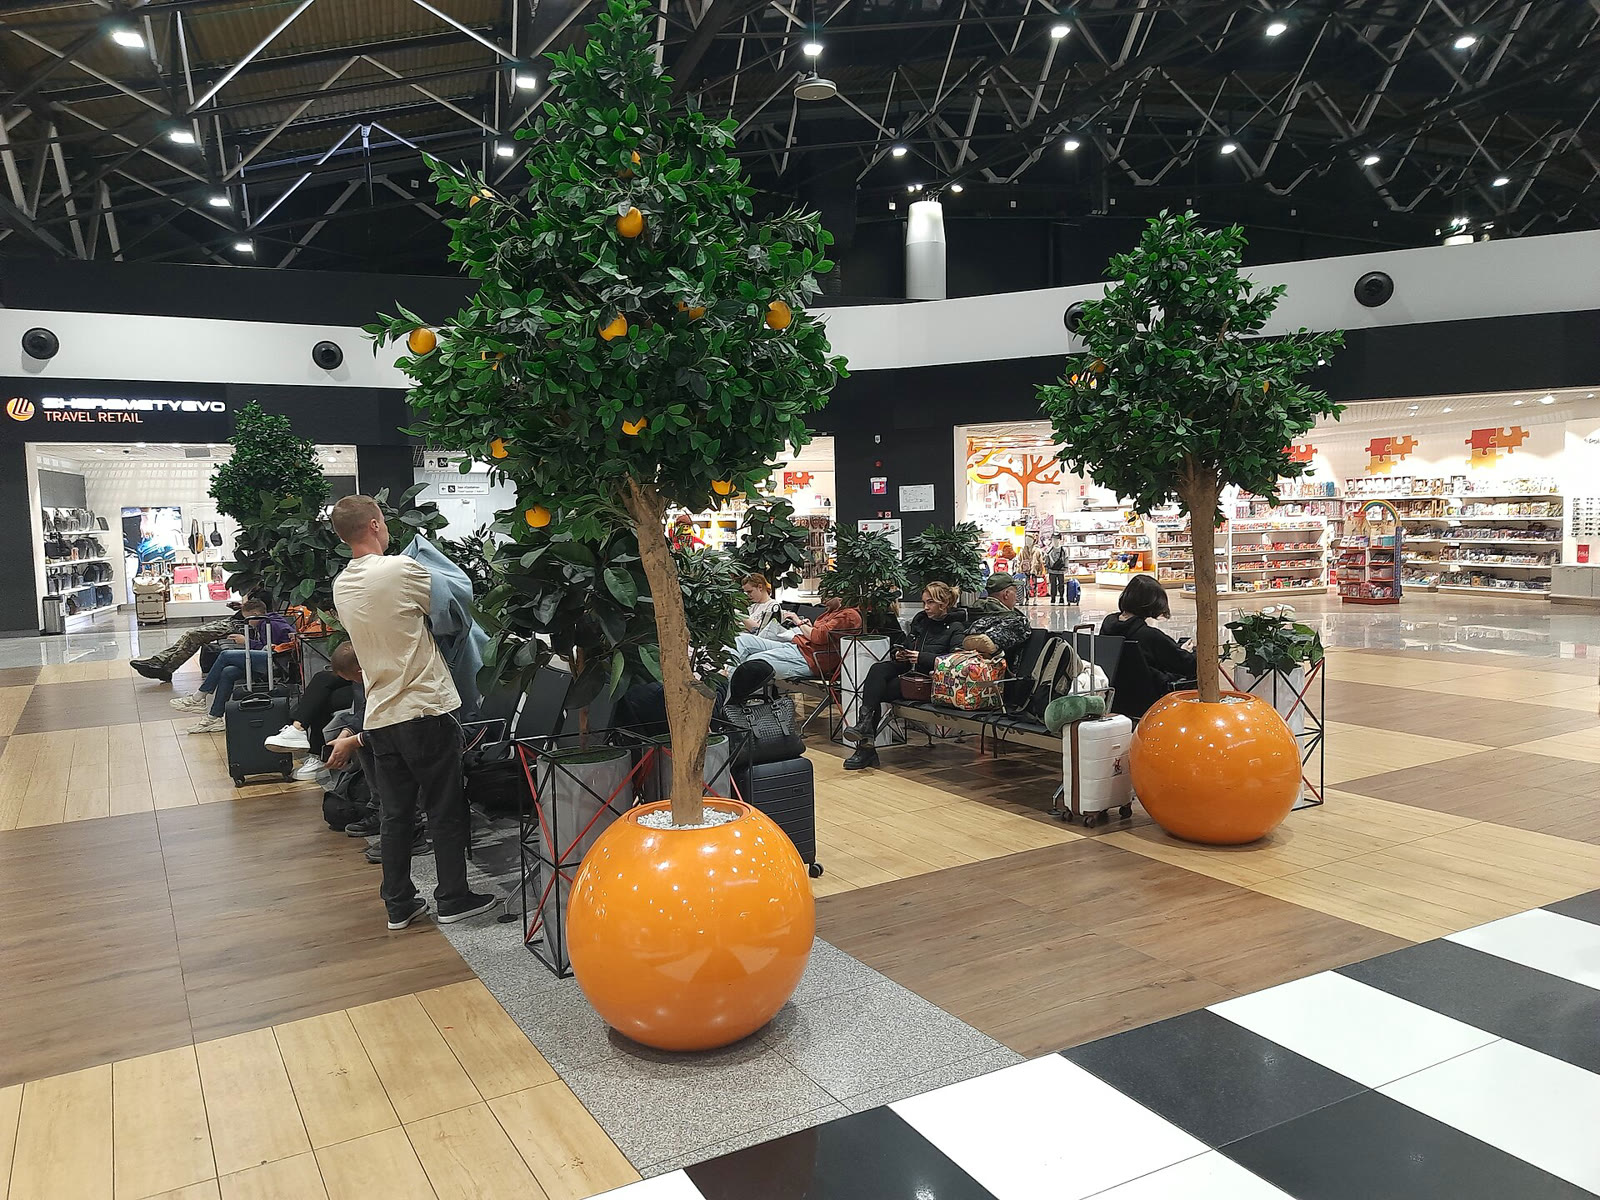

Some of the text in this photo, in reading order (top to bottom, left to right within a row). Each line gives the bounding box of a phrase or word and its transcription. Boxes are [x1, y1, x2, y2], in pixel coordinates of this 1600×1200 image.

[41, 397, 226, 412] SHEREMETYEVO
[44, 411, 143, 423] TRAVEL RETAIL
